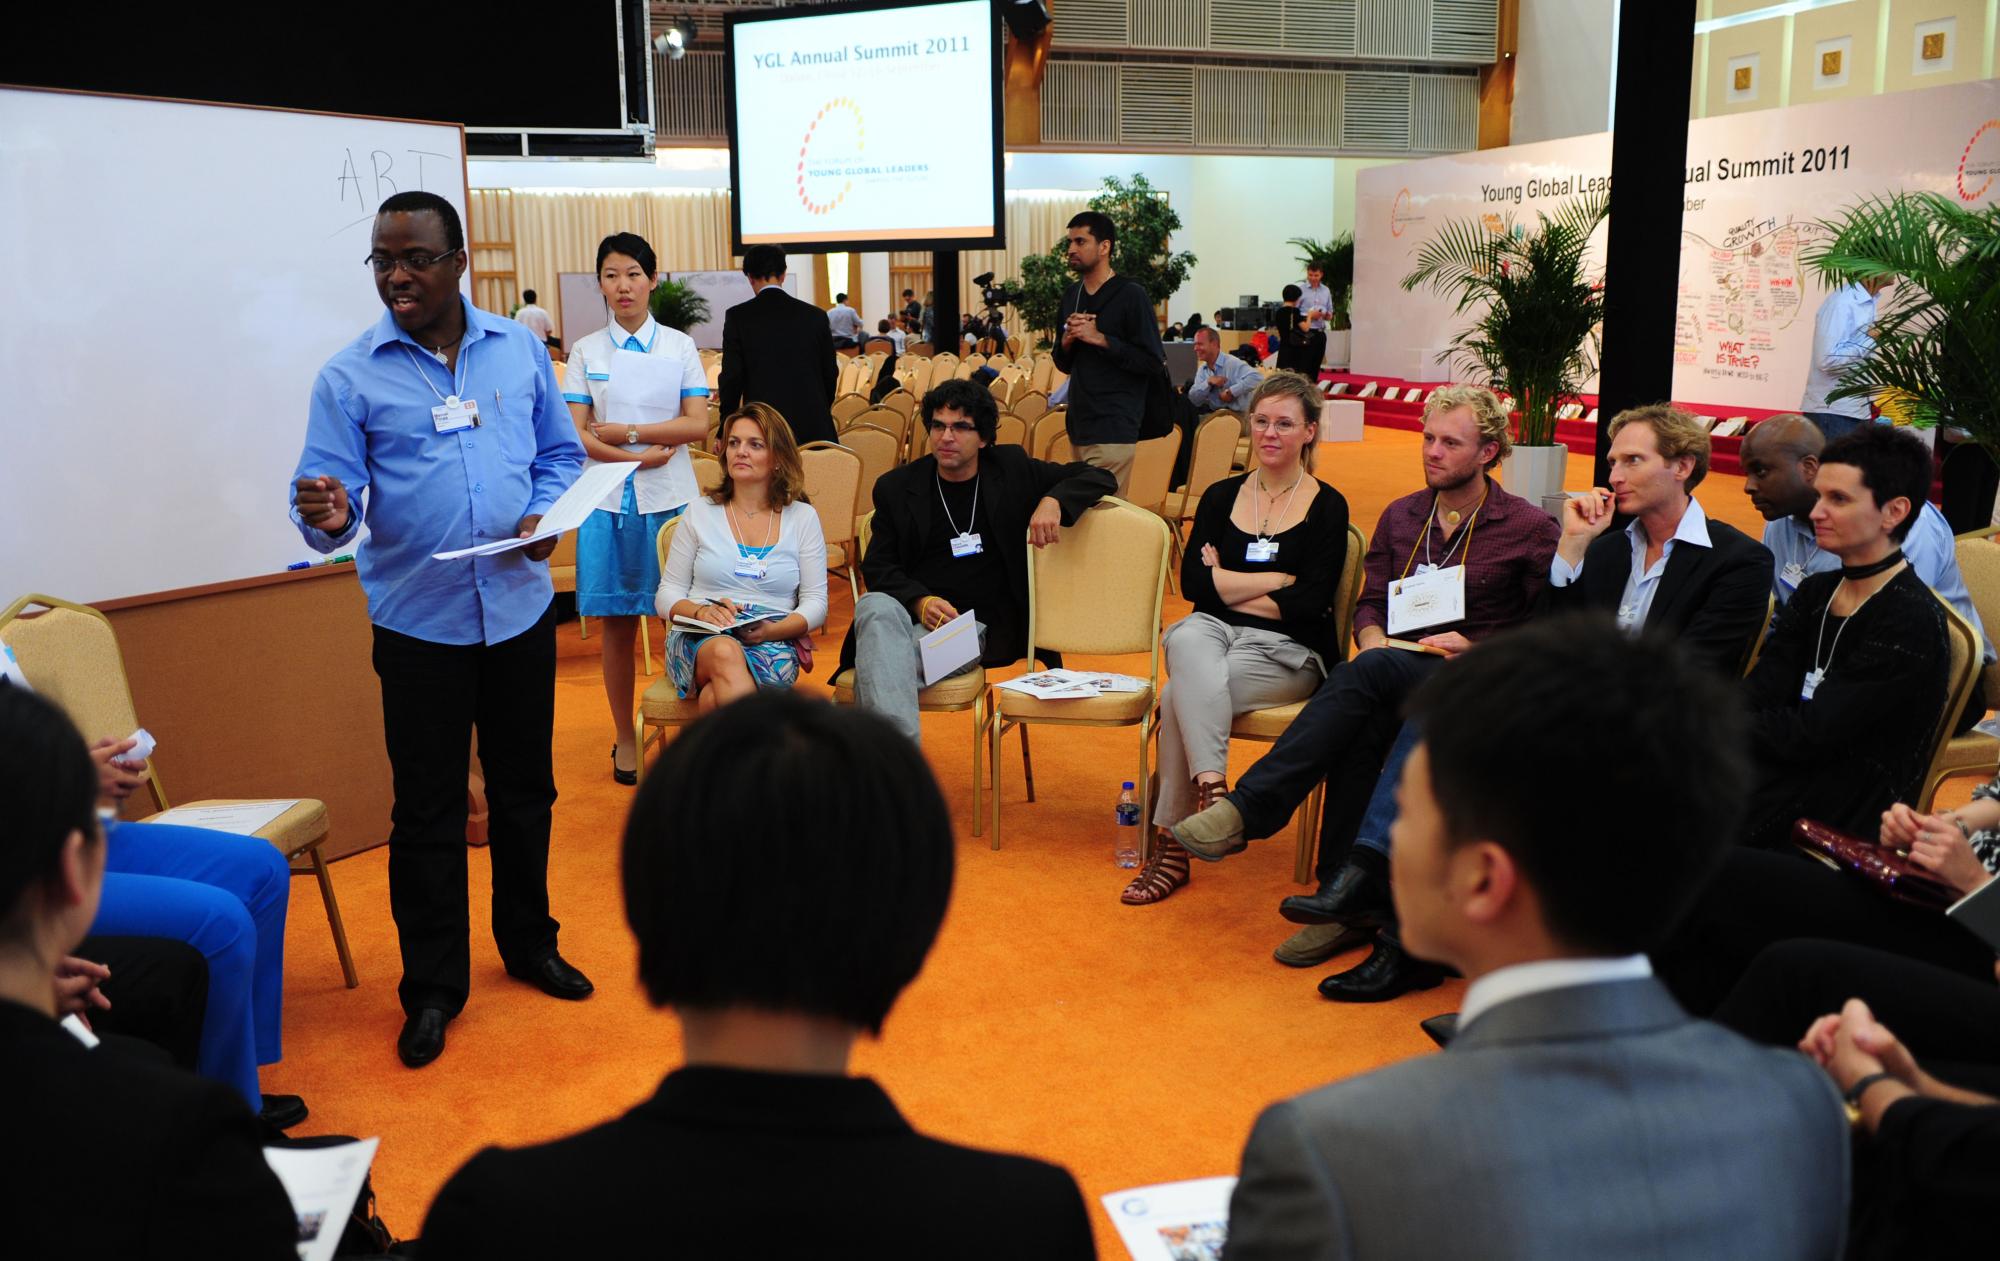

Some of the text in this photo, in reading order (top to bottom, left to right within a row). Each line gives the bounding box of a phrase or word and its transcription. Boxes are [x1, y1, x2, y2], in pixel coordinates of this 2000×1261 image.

[754, 36, 970, 69] YGL Annual Summit 2011
[808, 163, 929, 177] YOUNG GLOBAL LEADERS
[1481, 184, 1522, 204] Young
[1527, 175, 1573, 198] Global
[1685, 160, 1711, 183] ual
[1717, 152, 1795, 180] Summit
[1801, 145, 1850, 173] 2011
[1723, 216, 1776, 249] GROWTH
[1719, 341, 1745, 354] WHAT
